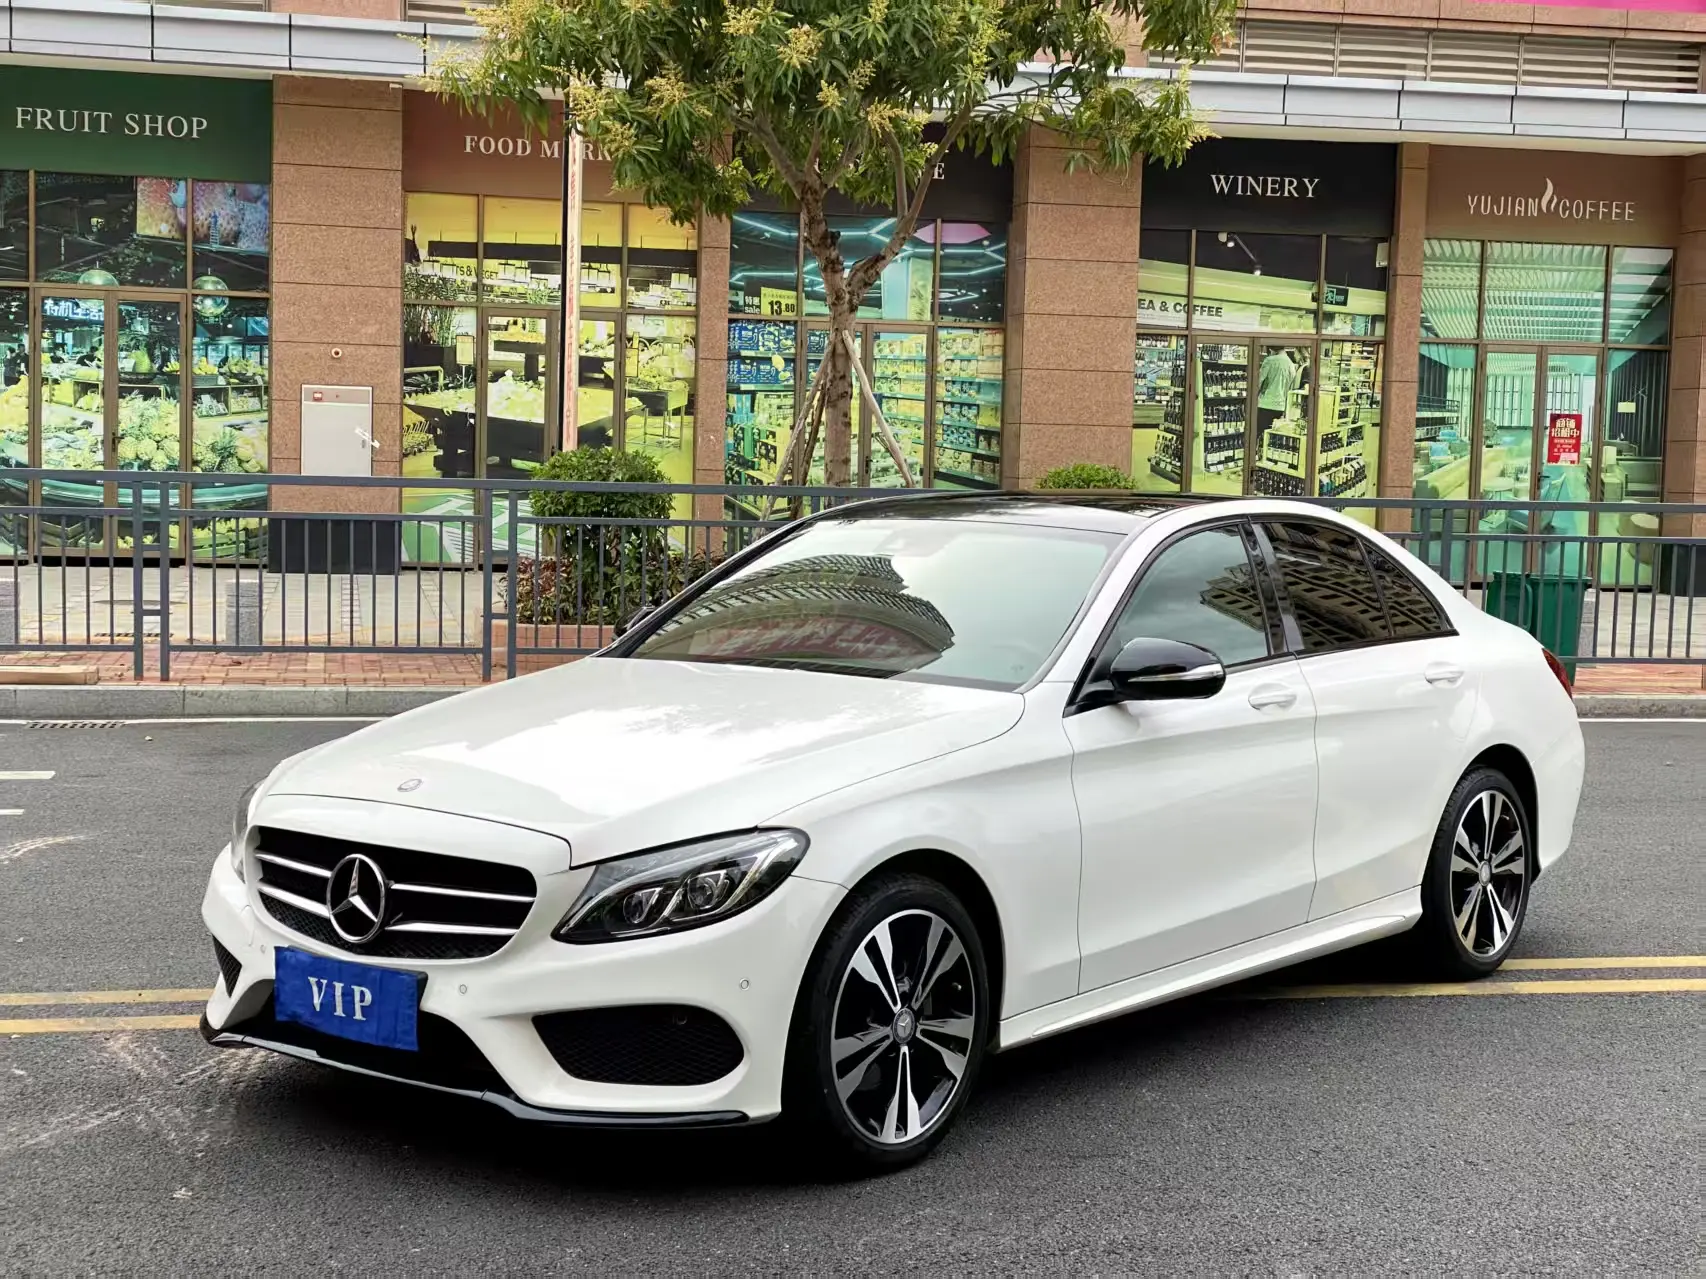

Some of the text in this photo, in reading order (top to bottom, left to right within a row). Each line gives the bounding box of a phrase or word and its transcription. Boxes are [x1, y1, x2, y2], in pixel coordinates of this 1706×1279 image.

[16, 106, 208, 139] FRUIT SHOP
[464, 135, 532, 157] FOOD
[1210, 174, 1320, 198] WINERY
[1467, 194, 1635, 221] YUJIAN COFFEE
[744, 305, 760, 314] sale
[1159, 301, 1169, 313] &
[308, 976, 372, 1021] VIP
